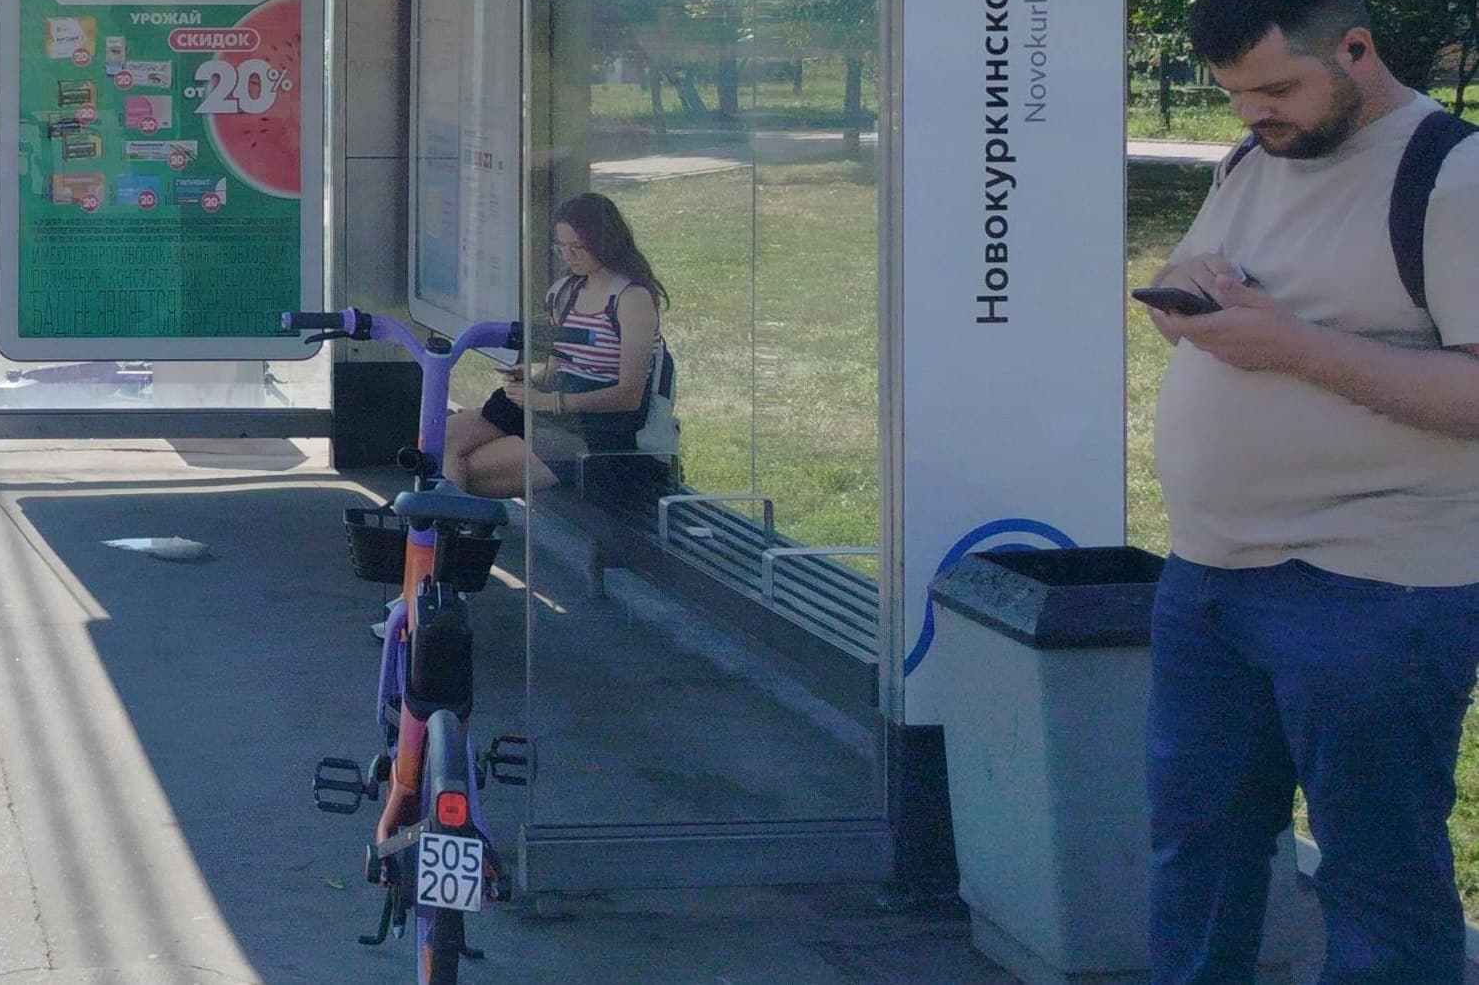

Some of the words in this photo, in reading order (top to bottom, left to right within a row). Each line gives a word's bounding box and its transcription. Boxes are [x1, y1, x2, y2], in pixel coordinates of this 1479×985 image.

[129, 9, 202, 25] УРОЖАЙ
[176, 33, 250, 48] СКИДОК
[204, 197, 218, 207] 20
[421, 836, 480, 873] 505
[420, 870, 480, 907] 207
